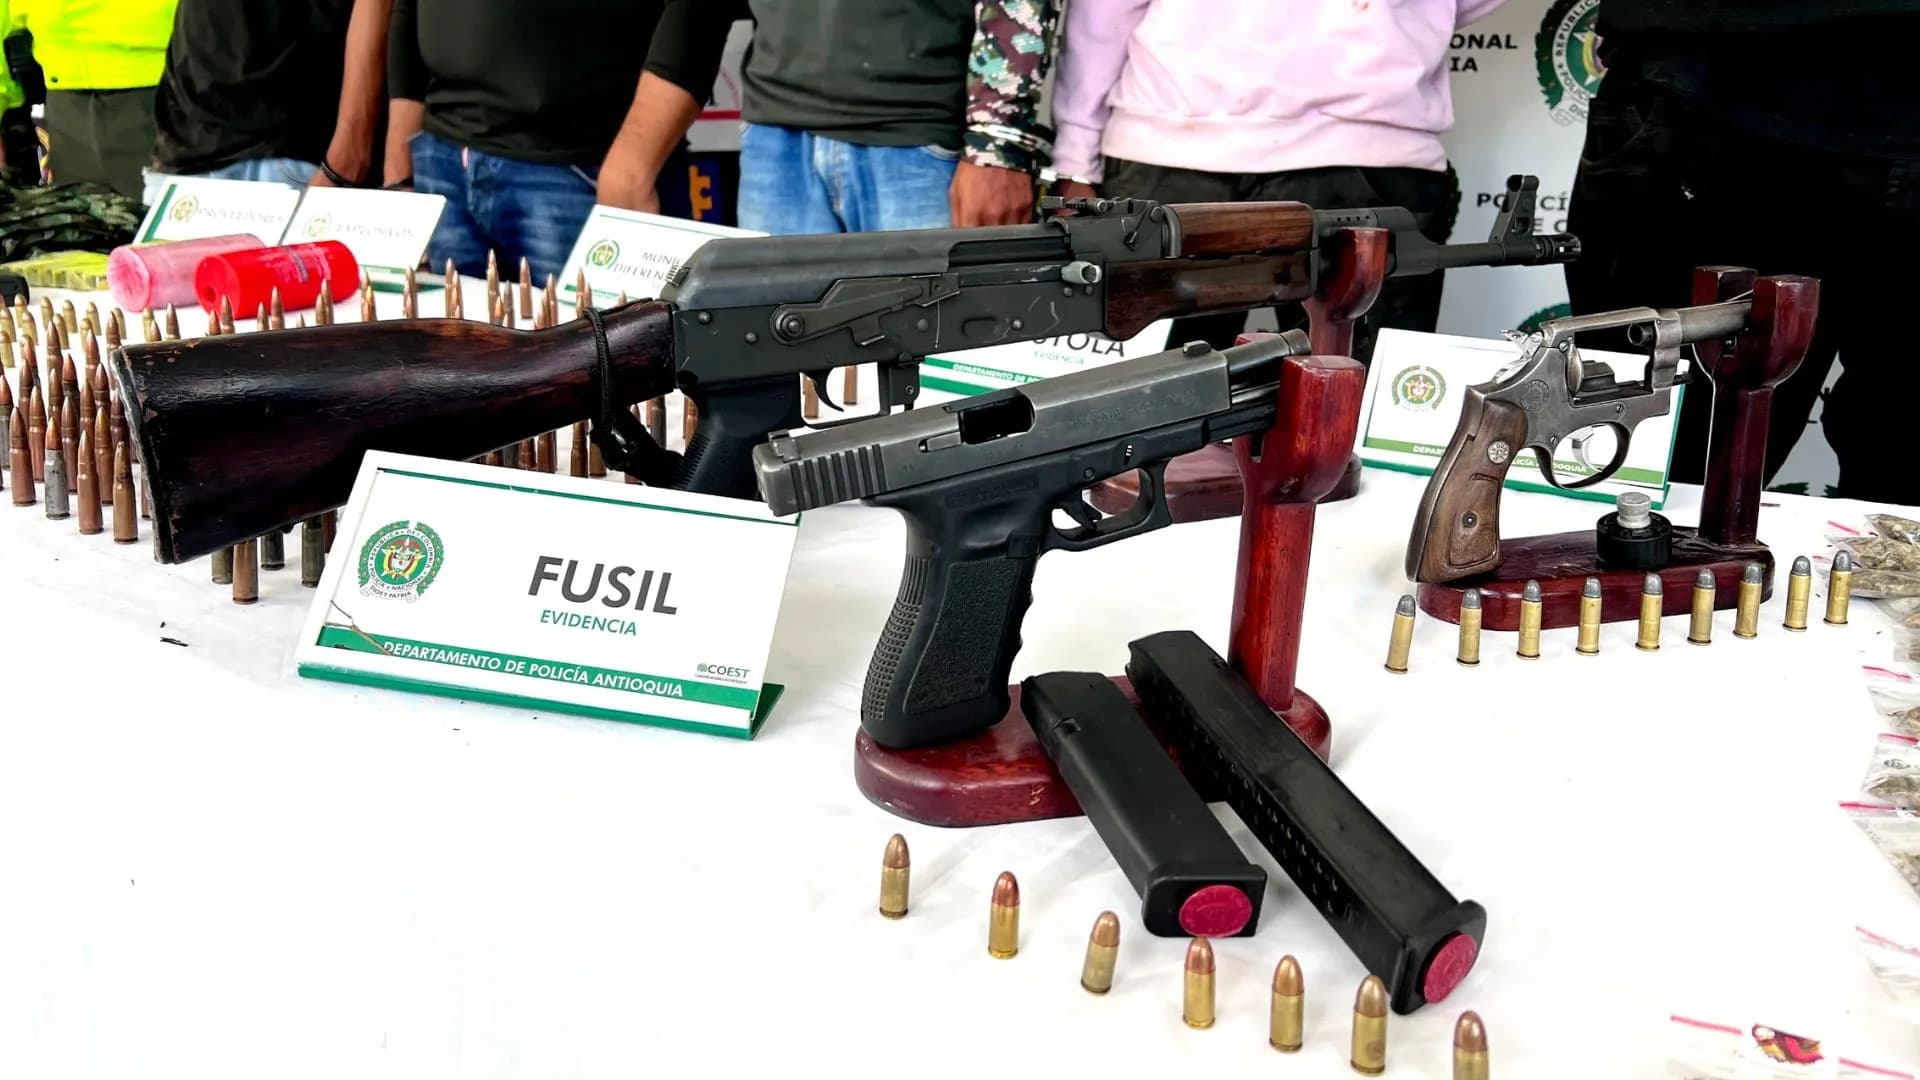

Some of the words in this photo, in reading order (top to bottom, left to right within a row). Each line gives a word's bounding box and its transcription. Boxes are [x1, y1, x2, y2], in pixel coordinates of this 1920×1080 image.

[528, 555, 678, 615] FUSIL
[540, 609, 637, 636] EVIDENCIA
[383, 641, 501, 670] DEPARTAMENTO
[504, 659, 526, 674] DE
[528, 663, 589, 684] POLICÍA
[591, 673, 683, 698] ANTIOQUIA
[707, 664, 750, 679] COEST
